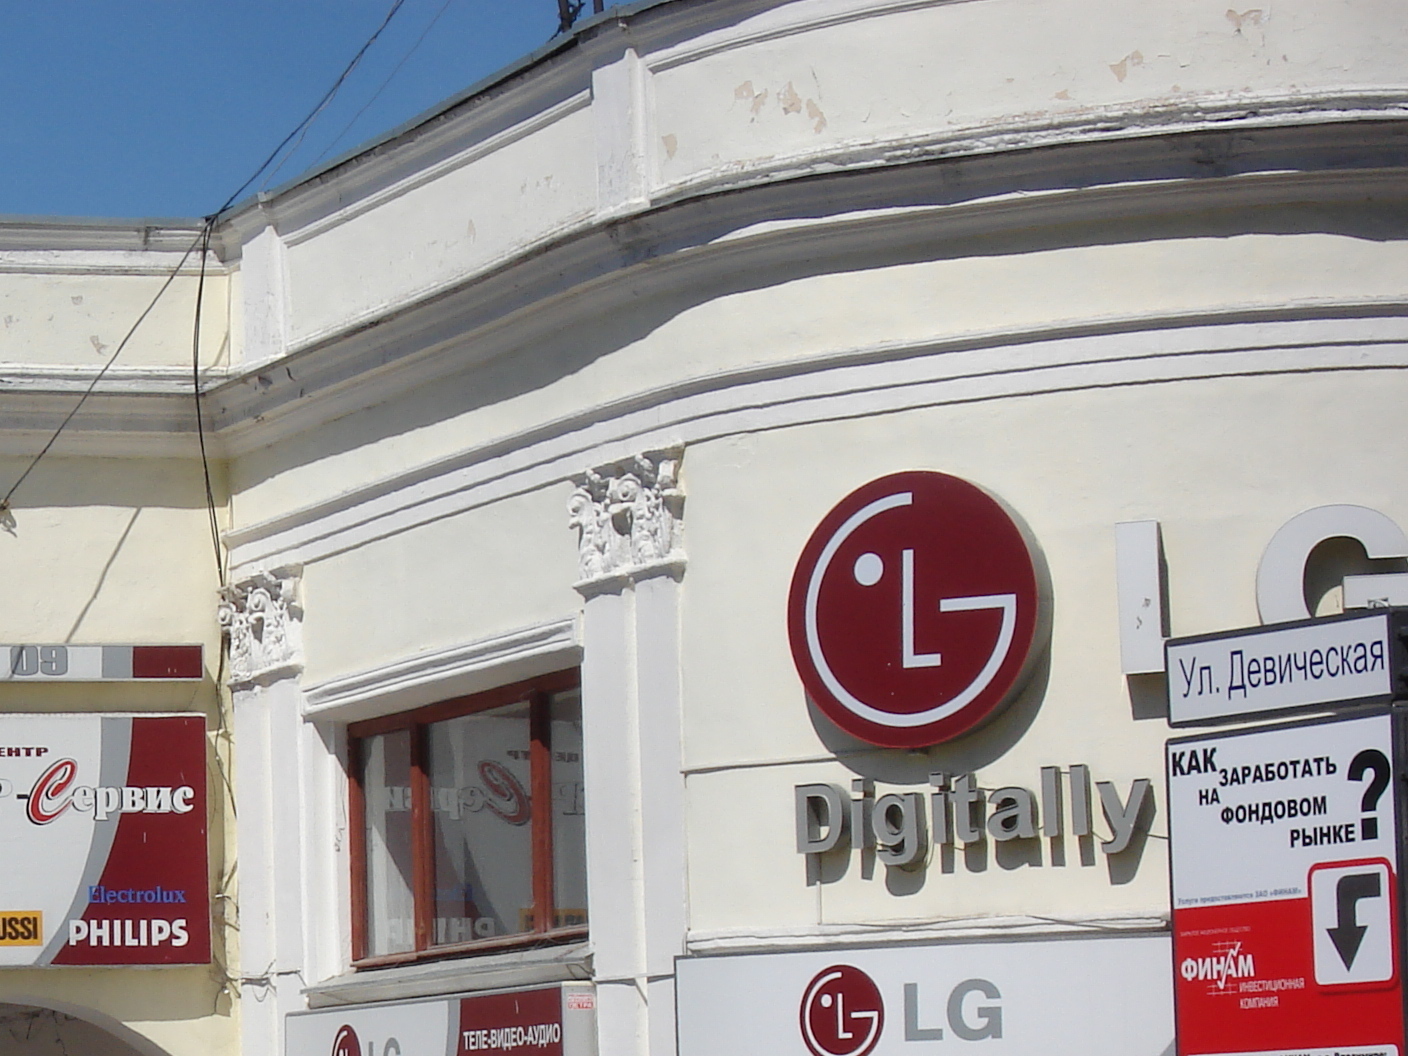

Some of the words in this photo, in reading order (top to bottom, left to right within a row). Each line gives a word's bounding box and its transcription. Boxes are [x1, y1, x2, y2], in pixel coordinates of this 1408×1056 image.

[10, 645, 68, 676] 09
[1179, 657, 1220, 698] Ул.
[1228, 640, 1385, 700] Девическая
[1171, 747, 1217, 776] КАК
[1219, 756, 1337, 787] ЗАРАБОТАТЬ
[1199, 788, 1220, 806] НА
[1221, 796, 1327, 825] ФОНДОВОМ
[794, 764, 1153, 866] Digitally
[1290, 823, 1355, 848] РЫНКЕ
[88, 885, 185, 903] Electrolux
[68, 918, 188, 946] PHILIPS
[1181, 954, 1254, 981] ФИНАМ
[903, 977, 1004, 1043] LG
[462, 1023, 561, 1051] ТЕЛЕ-ВИДЕО-АУДИО
